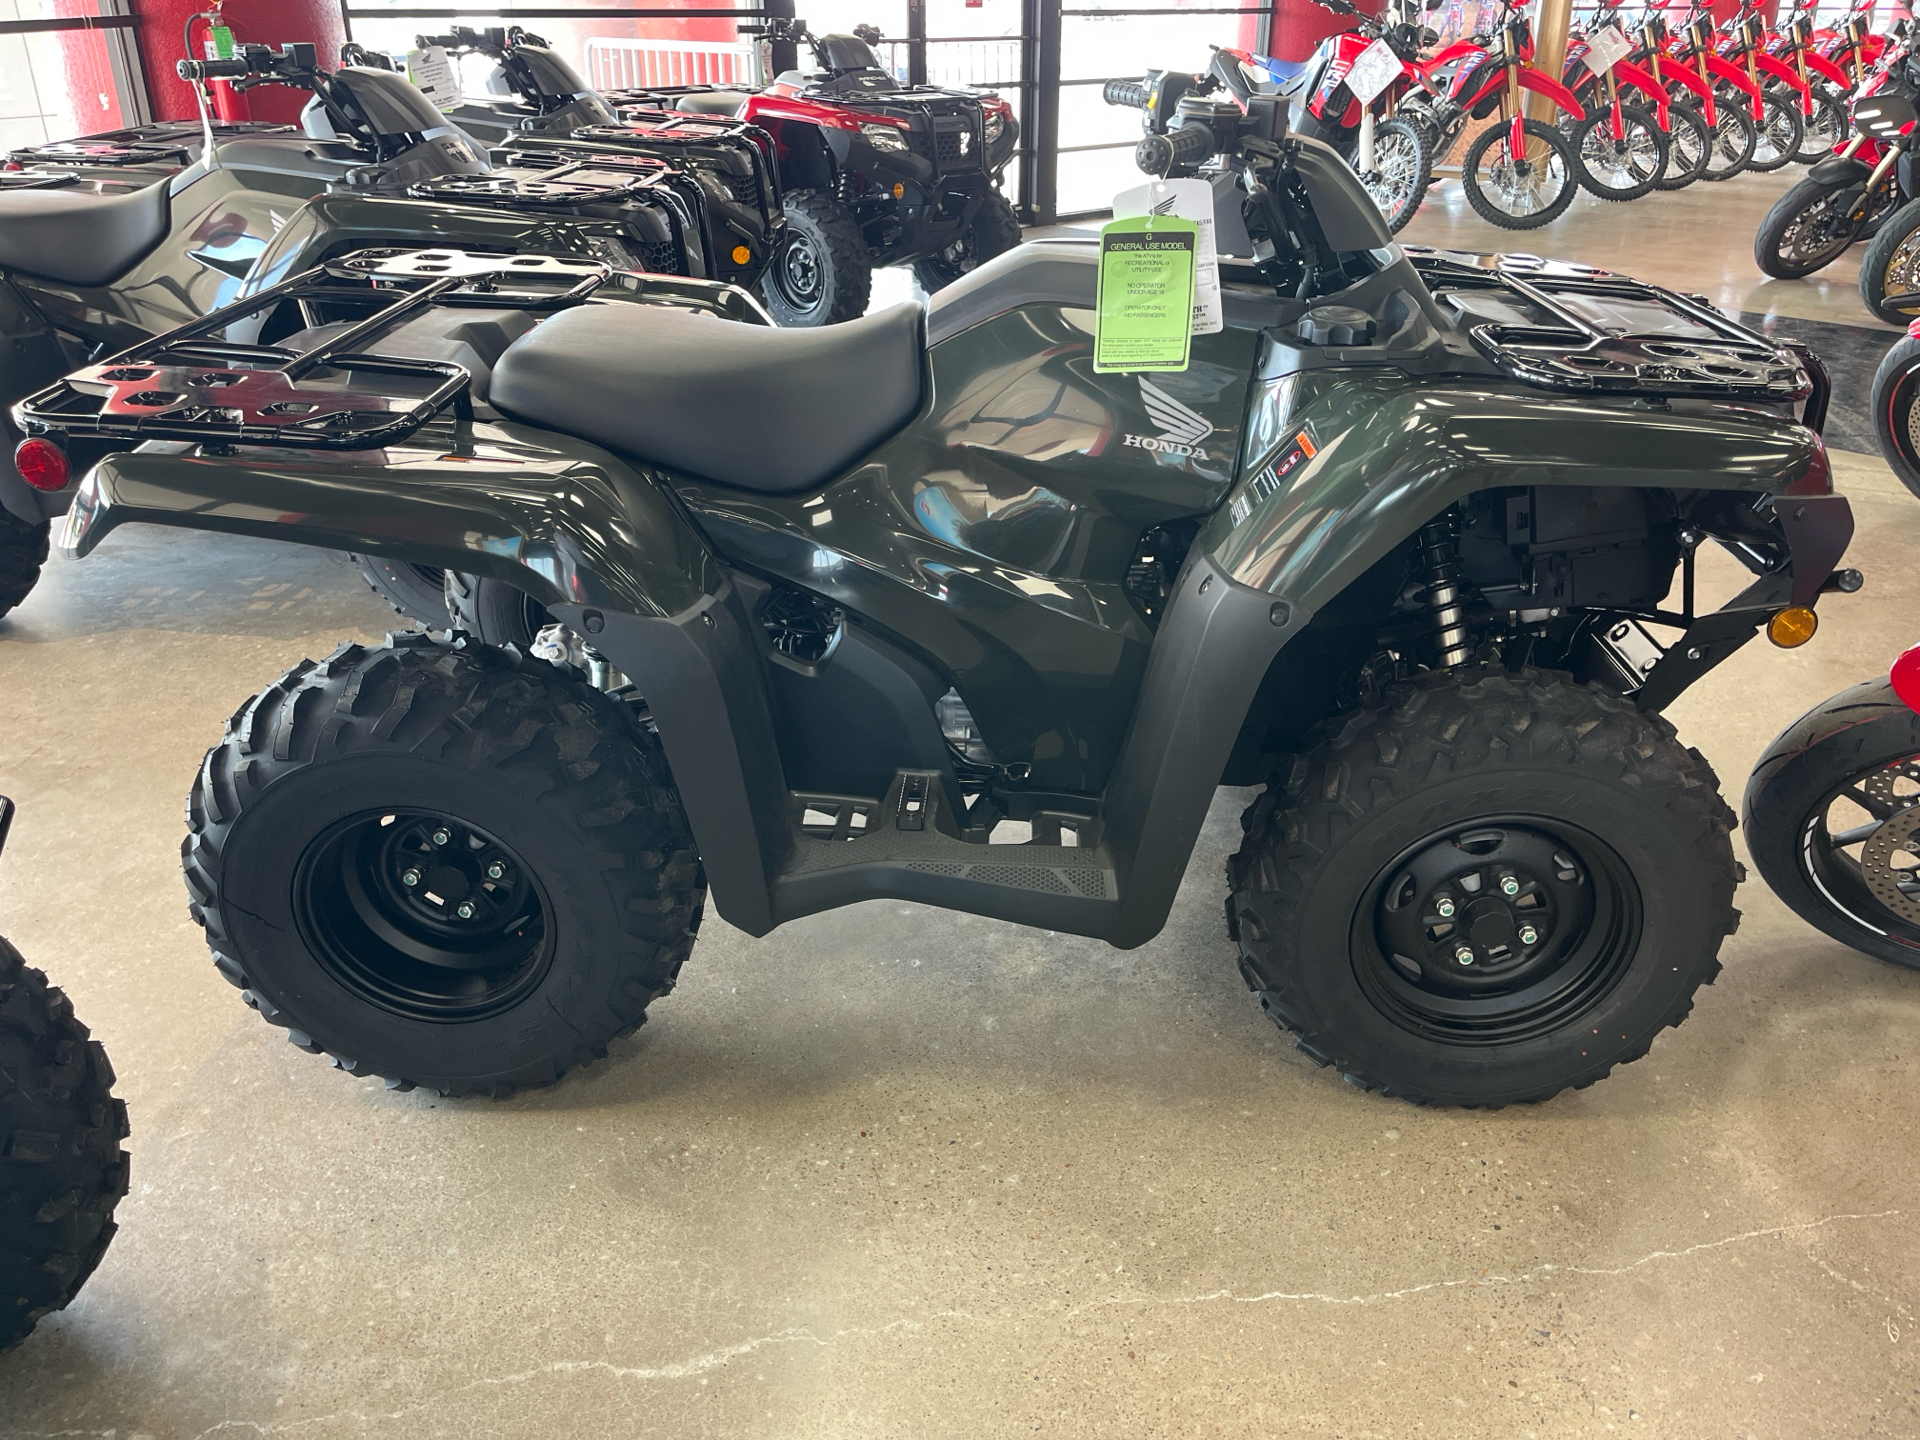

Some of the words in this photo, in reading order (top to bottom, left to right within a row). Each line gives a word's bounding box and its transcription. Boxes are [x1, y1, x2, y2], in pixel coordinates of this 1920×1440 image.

[935, 121, 968, 129] HONDA
[1145, 233, 1152, 241] G
[1110, 243, 1144, 251] GENERAL
[1145, 242, 1160, 250] USE
[1161, 242, 1186, 250] MODEL
[1123, 434, 1210, 461] HONDA
